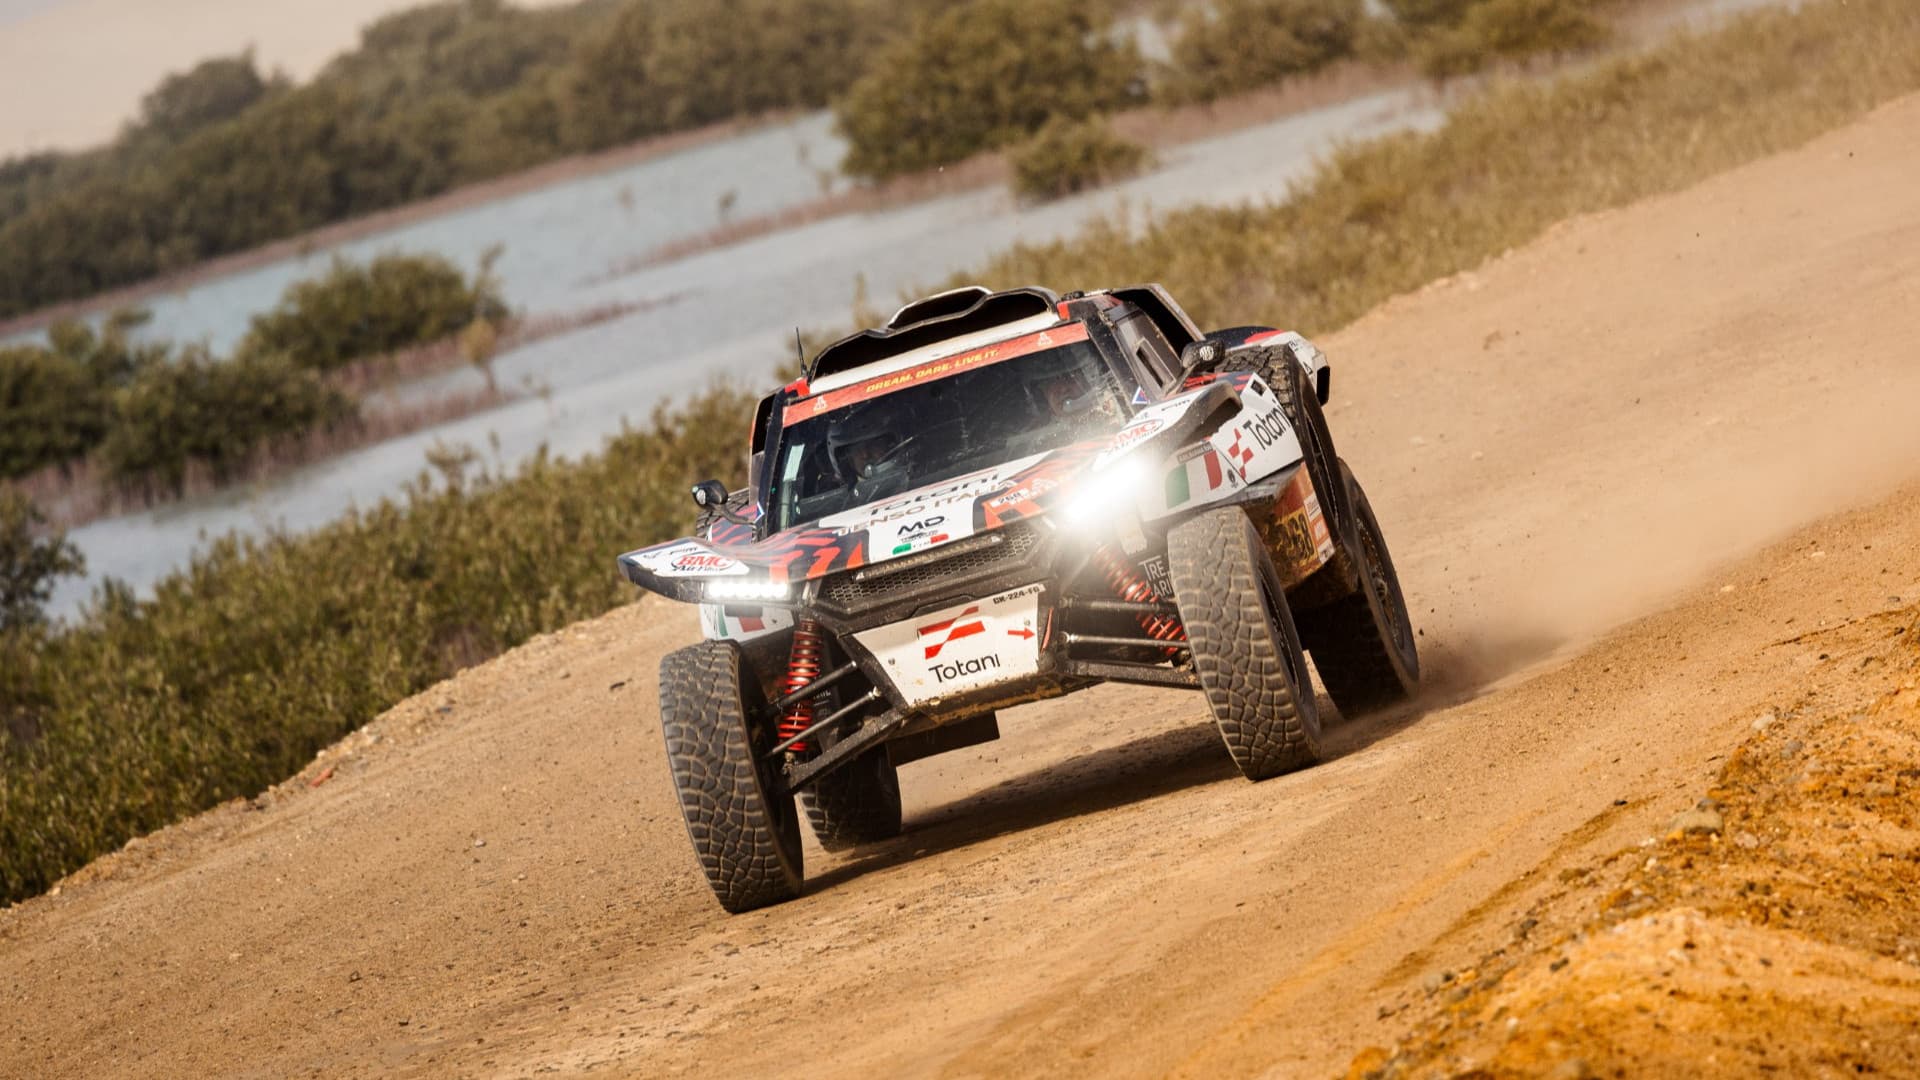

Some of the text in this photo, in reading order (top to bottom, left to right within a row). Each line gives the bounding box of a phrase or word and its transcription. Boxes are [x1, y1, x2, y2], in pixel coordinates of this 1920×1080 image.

[866, 374, 912, 393] DREAM.
[916, 363, 953, 379] DARE.
[955, 353, 982, 368] LIVE
[897, 515, 945, 535] MD
[677, 554, 730, 568] BMC
[928, 653, 1001, 684] Totani
